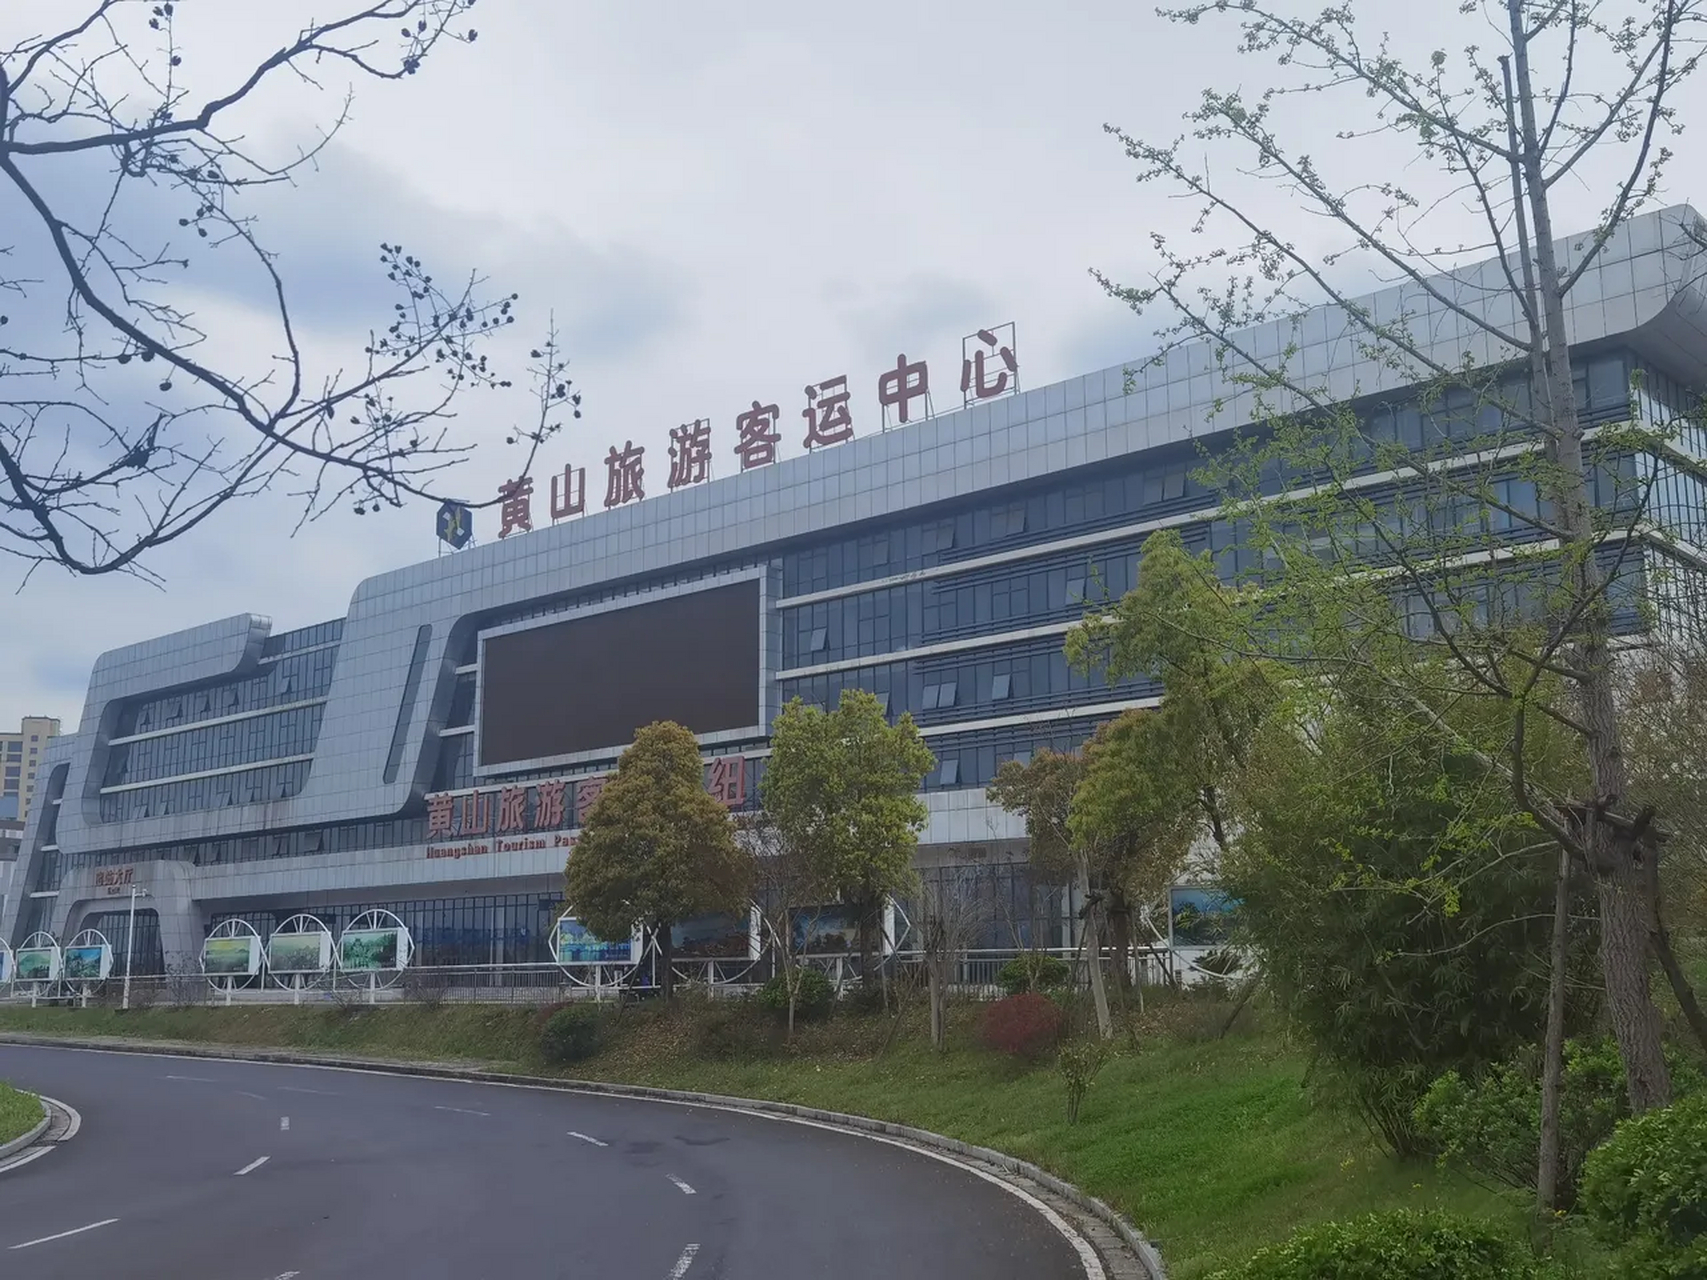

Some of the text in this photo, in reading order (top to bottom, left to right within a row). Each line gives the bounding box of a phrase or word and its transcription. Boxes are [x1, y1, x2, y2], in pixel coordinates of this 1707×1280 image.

[498, 329, 1017, 538] 黄山旅游客运中心
[426, 756, 745, 839] 黄山旅游客纽
[426, 844, 488, 860] Huangshan
[496, 837, 546, 853] Tourism
